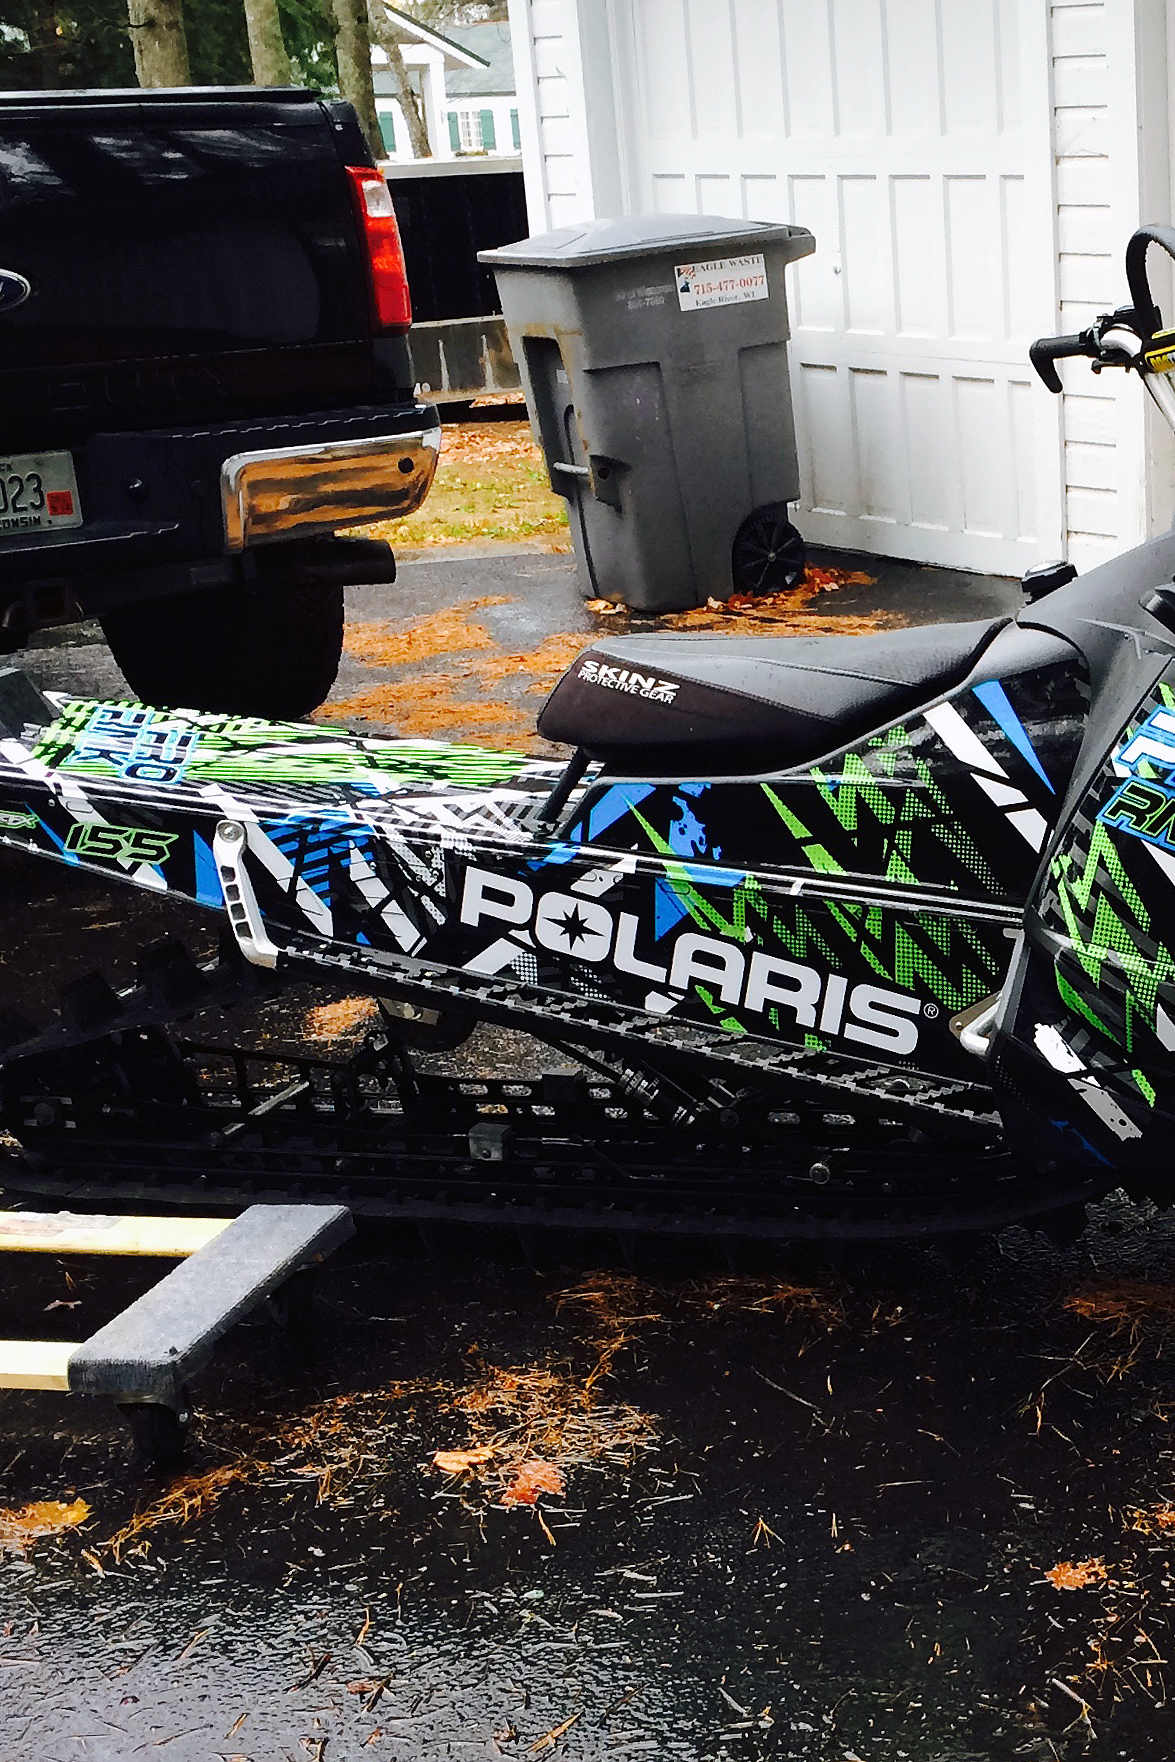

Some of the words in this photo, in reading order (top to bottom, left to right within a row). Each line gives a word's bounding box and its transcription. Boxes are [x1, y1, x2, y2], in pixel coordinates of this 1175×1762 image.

[691, 261, 727, 273] EAGLE
[729, 256, 762, 267] WASTE
[693, 275, 765, 295] 715-477-0077
[695, 297, 717, 307] Eagle
[743, 291, 756, 299] WI
[0, 515, 41, 530] ONSIN
[577, 669, 640, 695] PROTECTIVE
[639, 688, 675, 705] GEAR
[581, 660, 681, 697] SKINZ
[64, 821, 179, 864] 155
